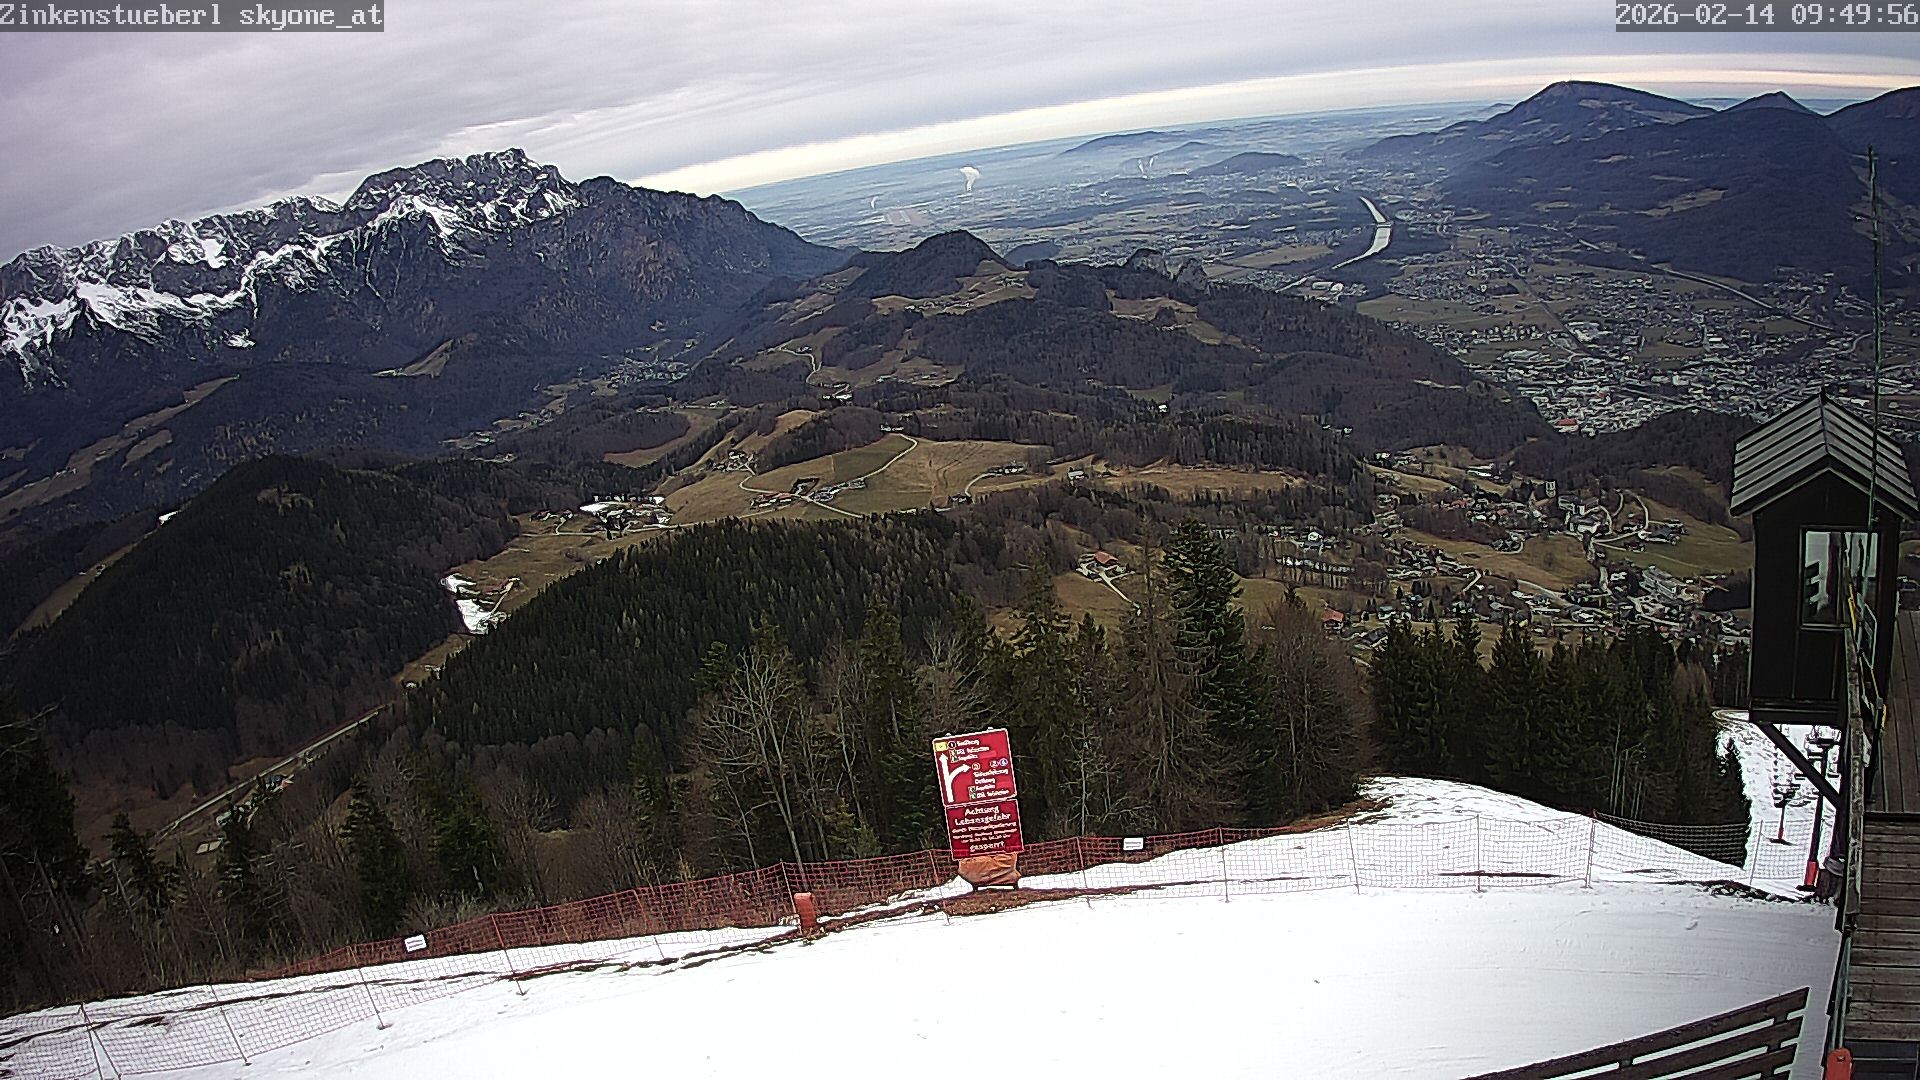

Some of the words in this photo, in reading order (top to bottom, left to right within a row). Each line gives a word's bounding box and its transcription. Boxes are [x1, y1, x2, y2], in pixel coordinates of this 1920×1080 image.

[965, 805, 999, 816] Achtung
[955, 813, 1011, 825] Lebensgefahr
[970, 841, 1005, 852] gesperrt
